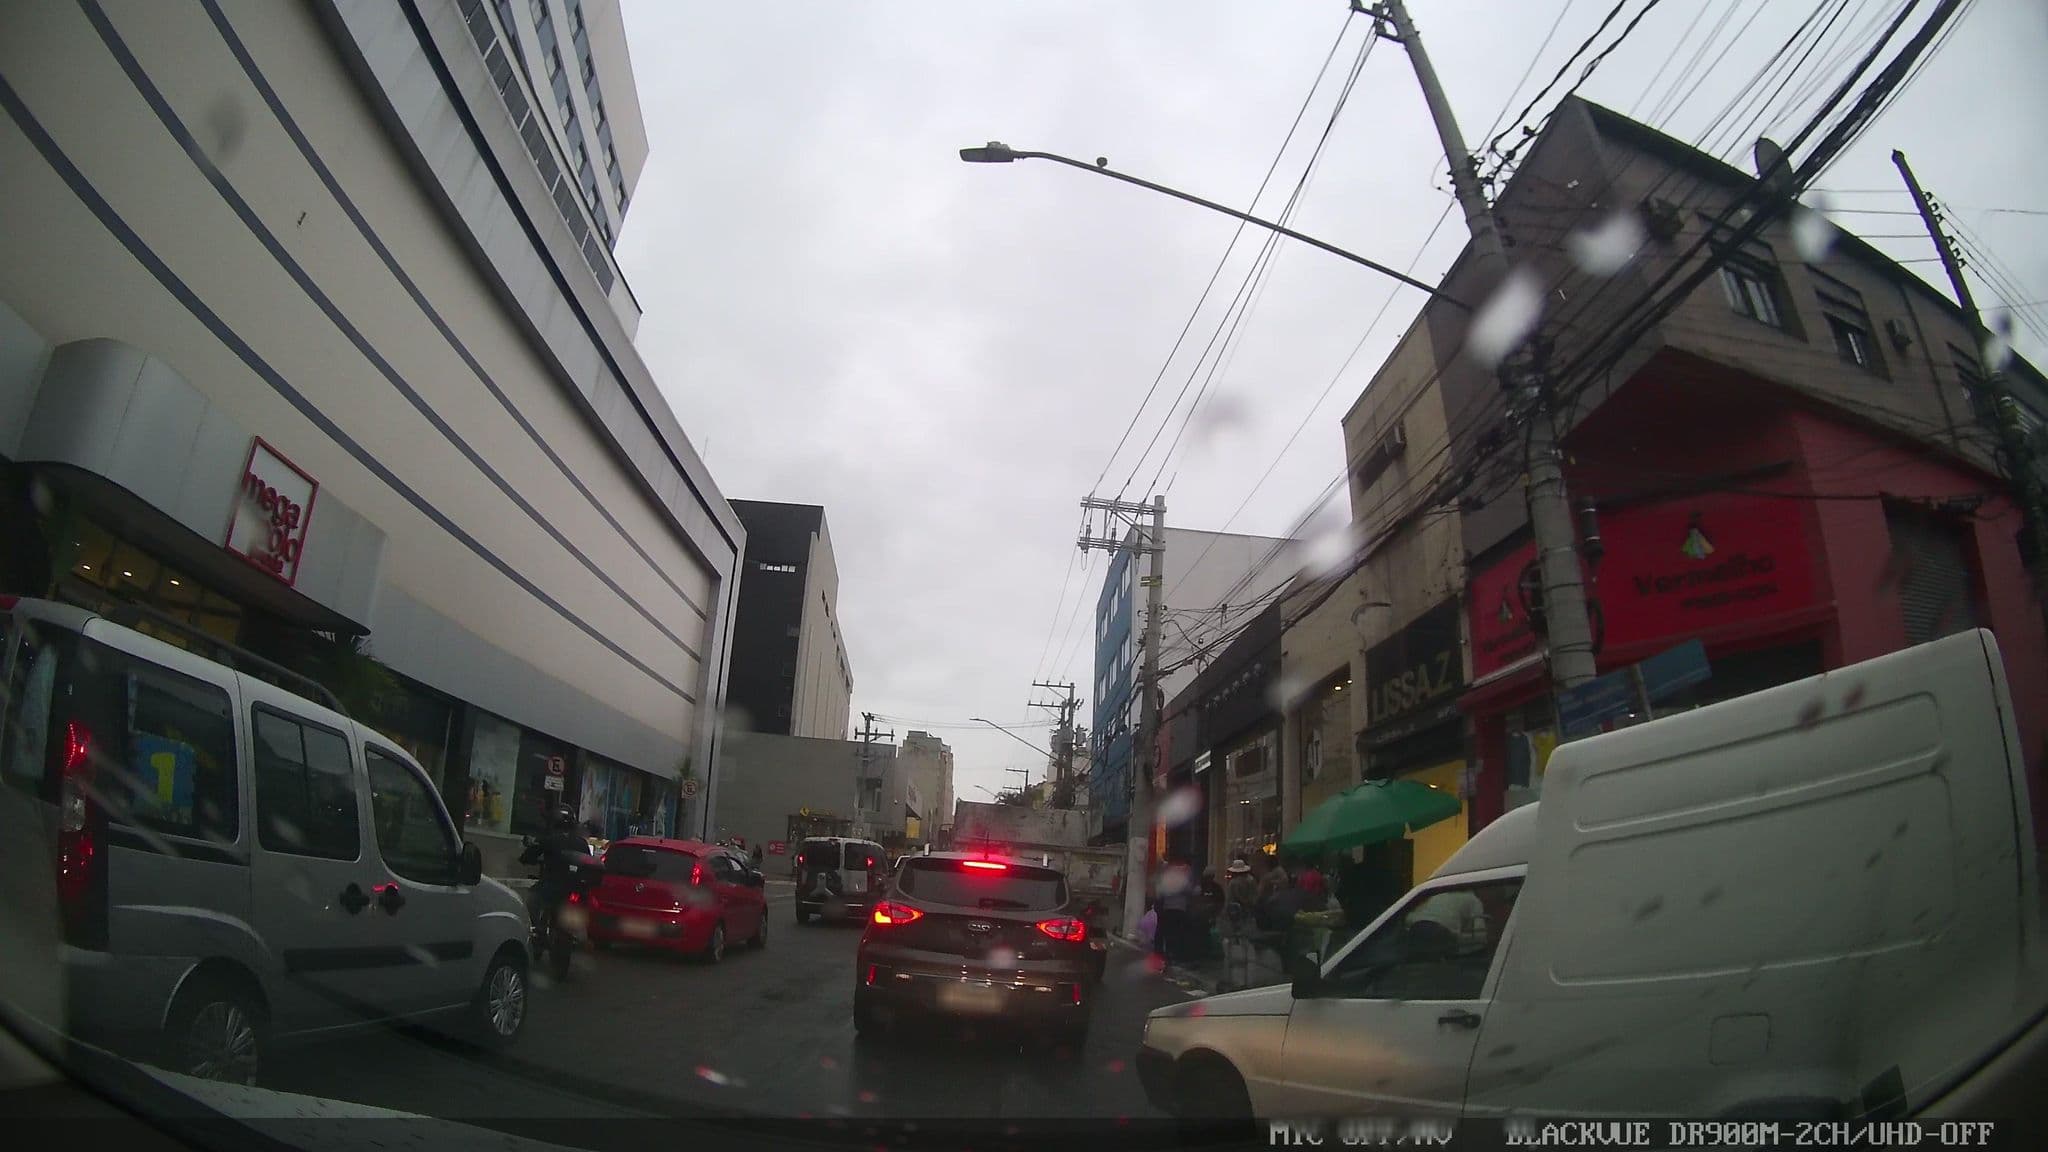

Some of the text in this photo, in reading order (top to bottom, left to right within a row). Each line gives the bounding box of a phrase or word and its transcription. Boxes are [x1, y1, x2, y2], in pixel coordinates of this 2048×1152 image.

[242, 471, 301, 529] mega
[1372, 663, 1432, 722] LISSA
[150, 751, 177, 805] 1
